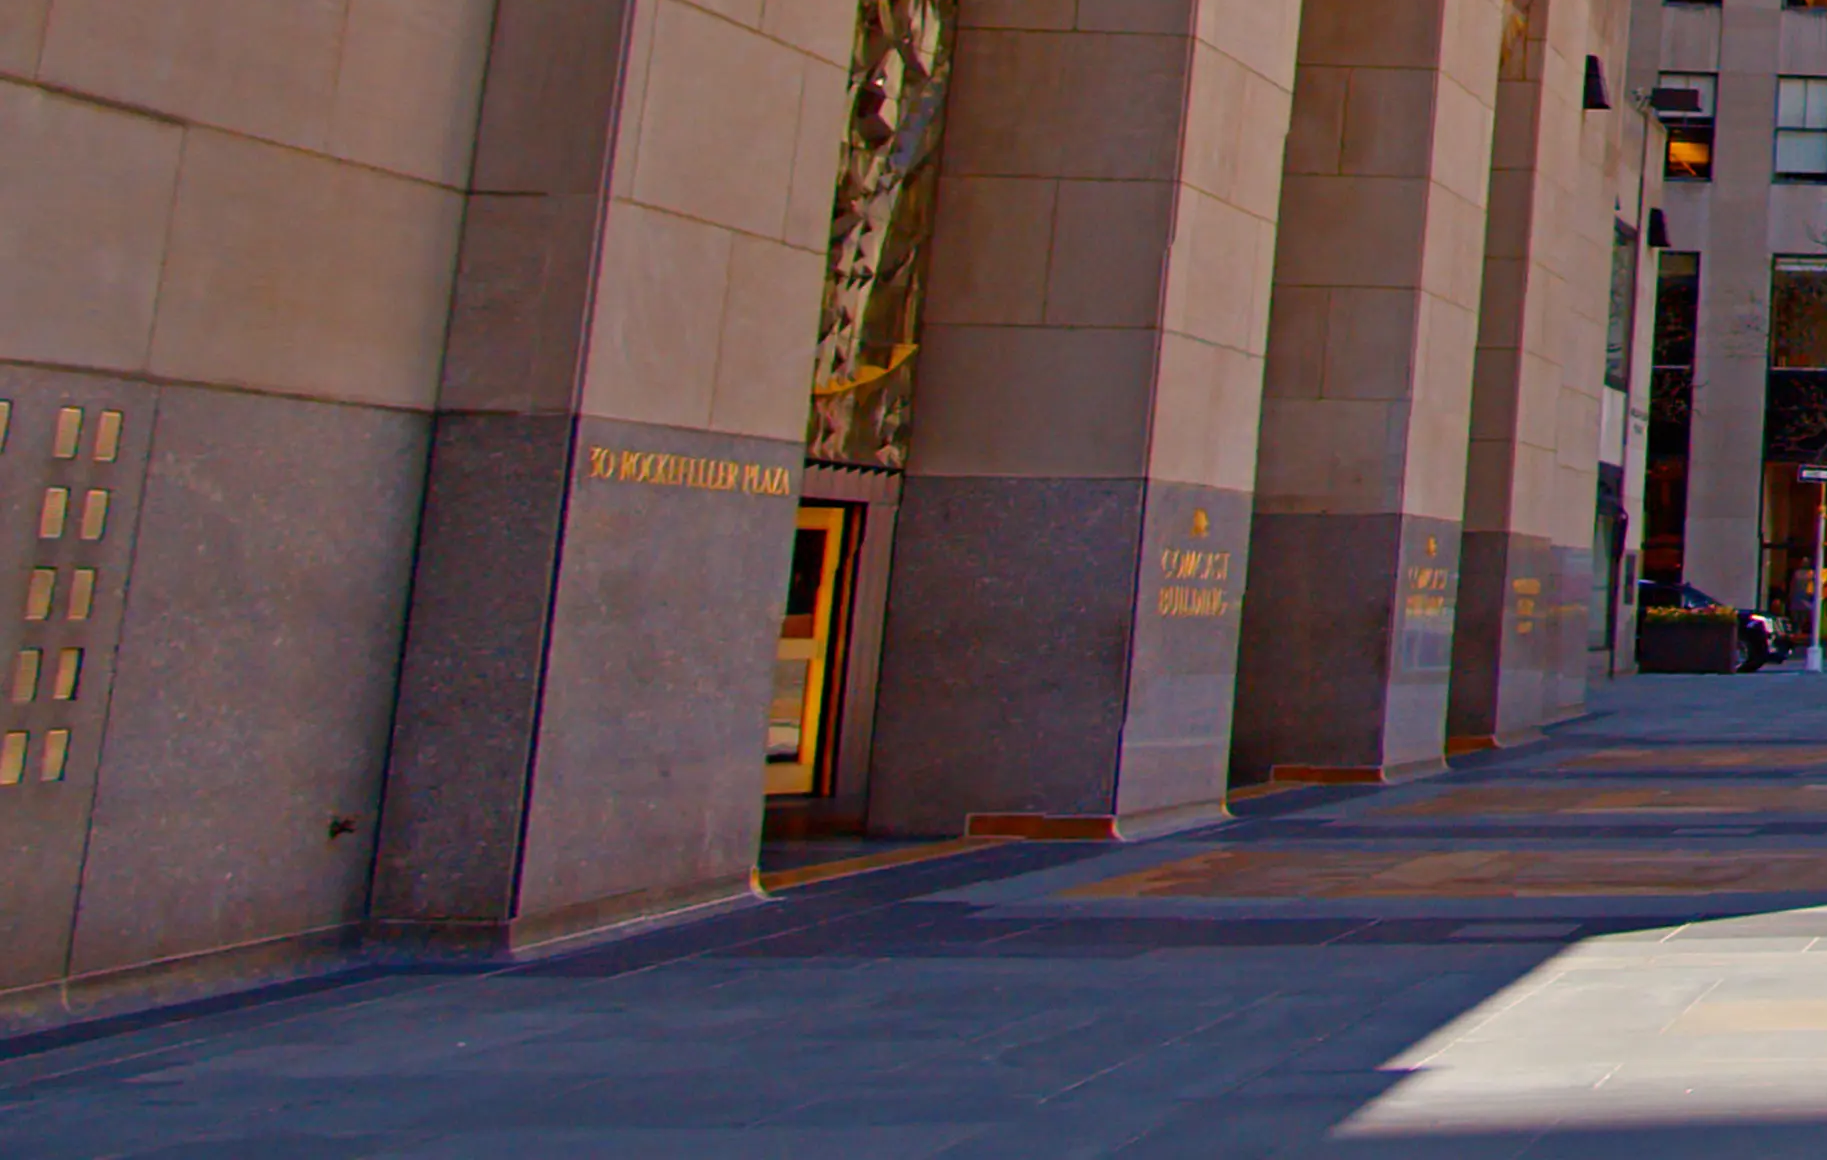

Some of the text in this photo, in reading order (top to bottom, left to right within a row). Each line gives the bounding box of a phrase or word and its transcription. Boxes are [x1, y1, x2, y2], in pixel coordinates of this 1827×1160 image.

[589, 445, 791, 496] 30 ROCKEFELLER PLAZA
